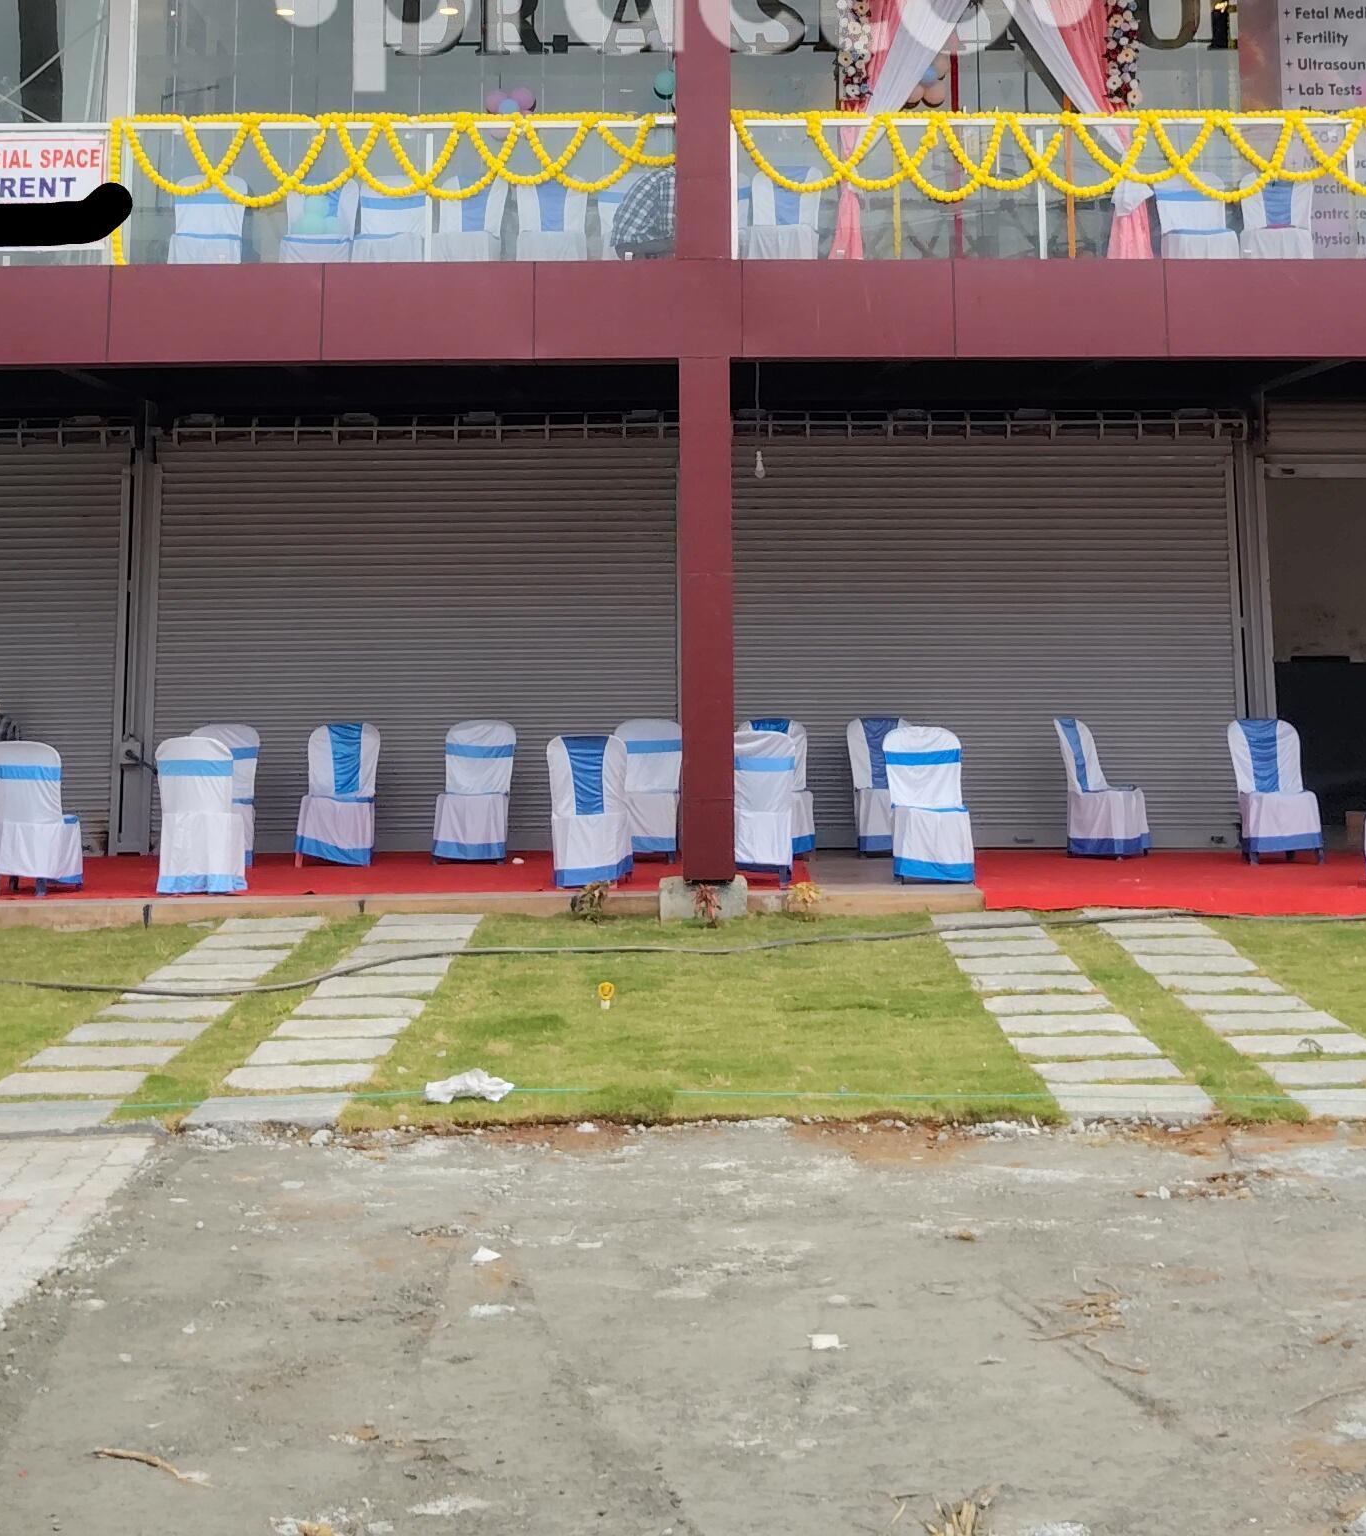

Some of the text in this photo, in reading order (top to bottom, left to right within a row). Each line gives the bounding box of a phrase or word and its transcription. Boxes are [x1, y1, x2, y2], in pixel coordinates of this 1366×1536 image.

[1295, 7, 1329, 19] Fetal
[1296, 31, 1348, 47] Fertility
[1299, 83, 1363, 95] Lab Tests
[39, 149, 101, 168] SPACE
[0, 177, 77, 198] RENT
